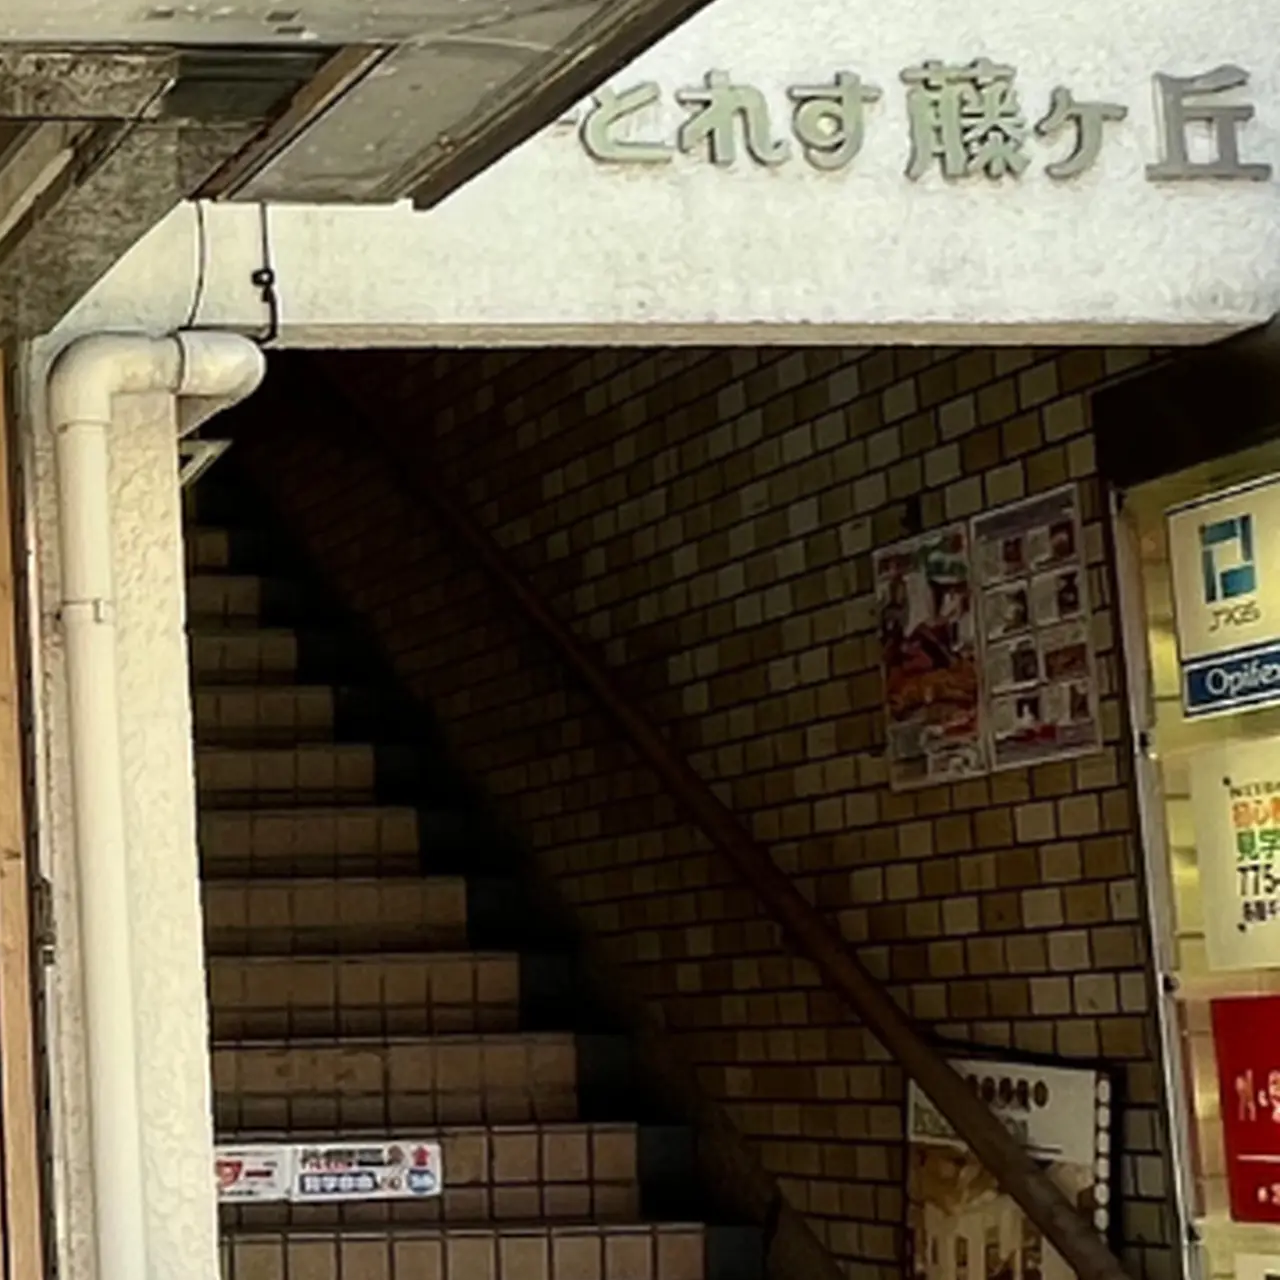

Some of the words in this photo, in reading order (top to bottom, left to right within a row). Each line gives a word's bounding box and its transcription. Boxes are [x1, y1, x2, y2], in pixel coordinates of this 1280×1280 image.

[566, 57, 1273, 184] とれす藤ヶ丘
